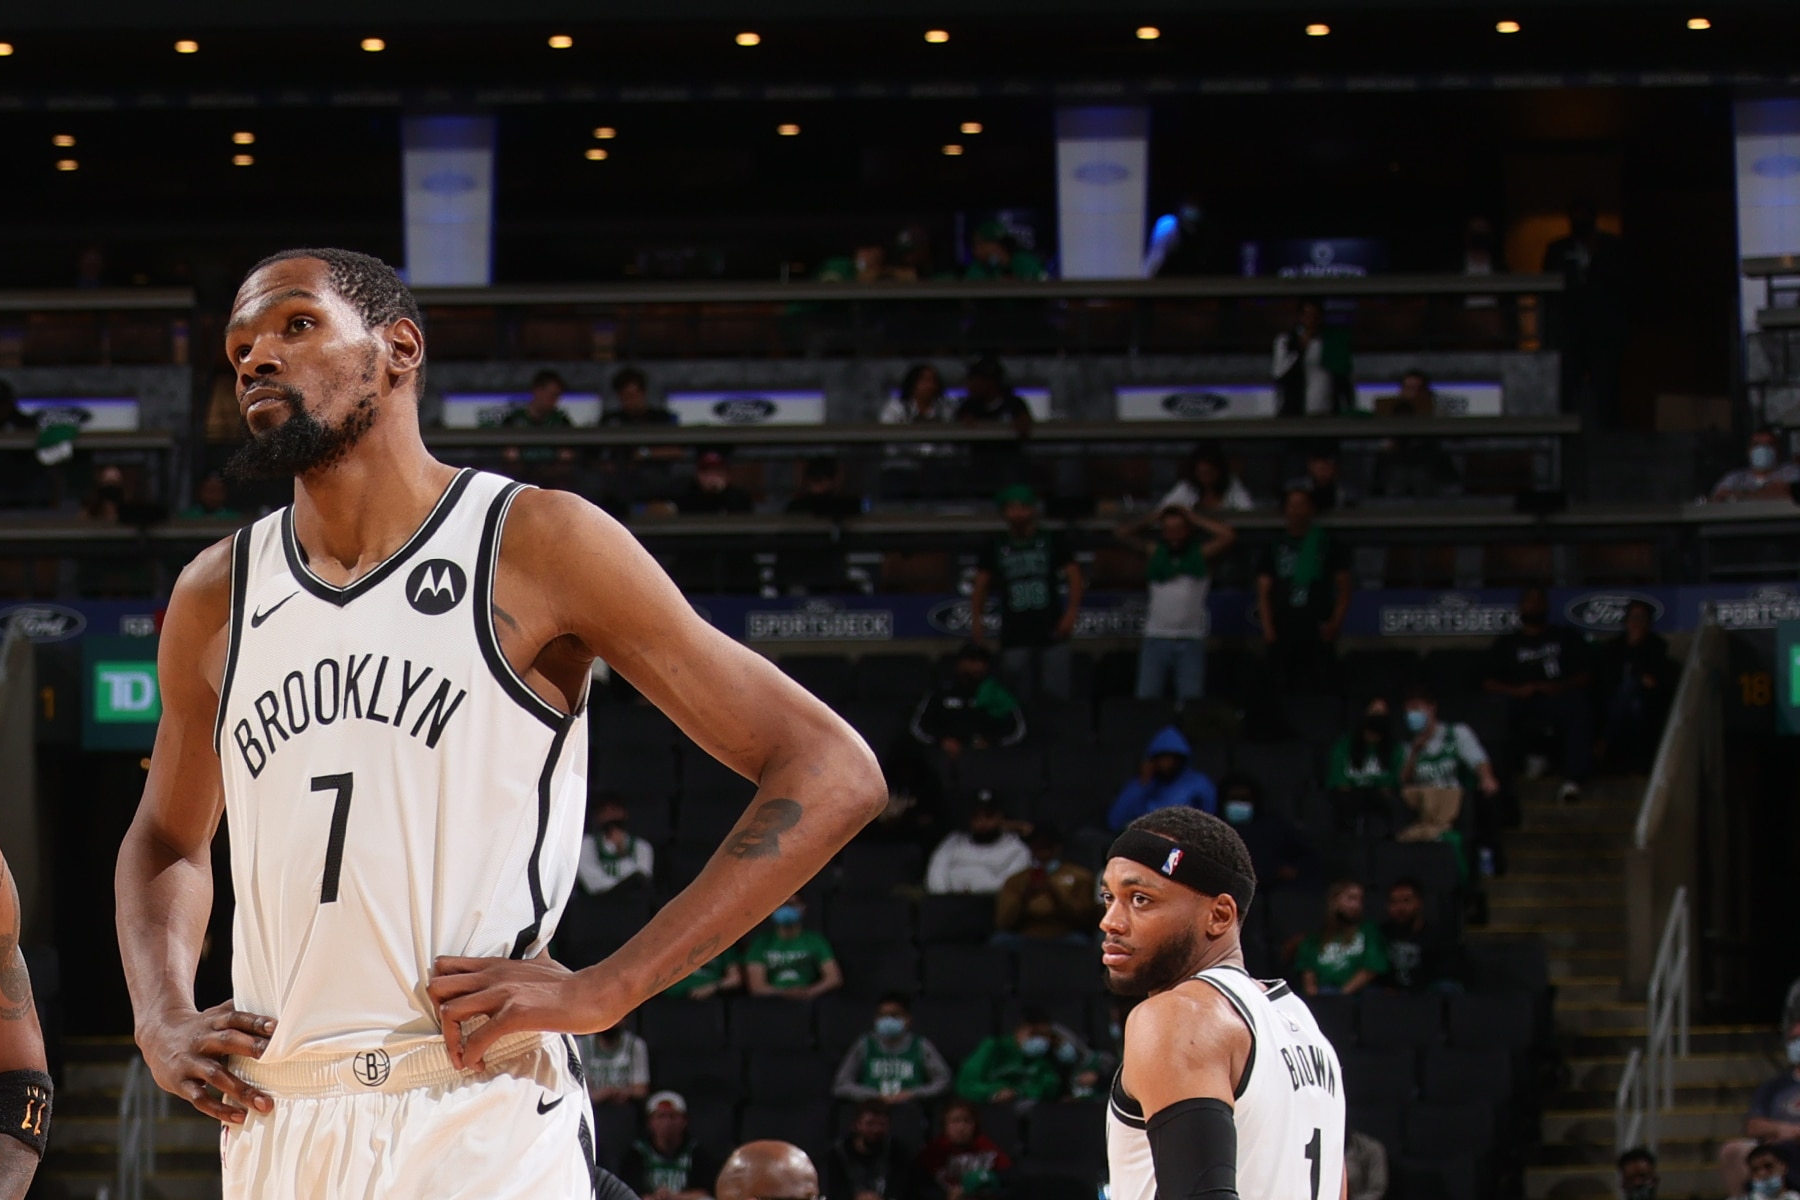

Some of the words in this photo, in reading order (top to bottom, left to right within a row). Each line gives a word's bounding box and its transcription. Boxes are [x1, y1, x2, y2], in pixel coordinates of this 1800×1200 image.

[100, 671, 156, 712] TD
[233, 653, 467, 780] BROOKLYN
[1738, 672, 1772, 706] 18
[310, 771, 354, 904] 7
